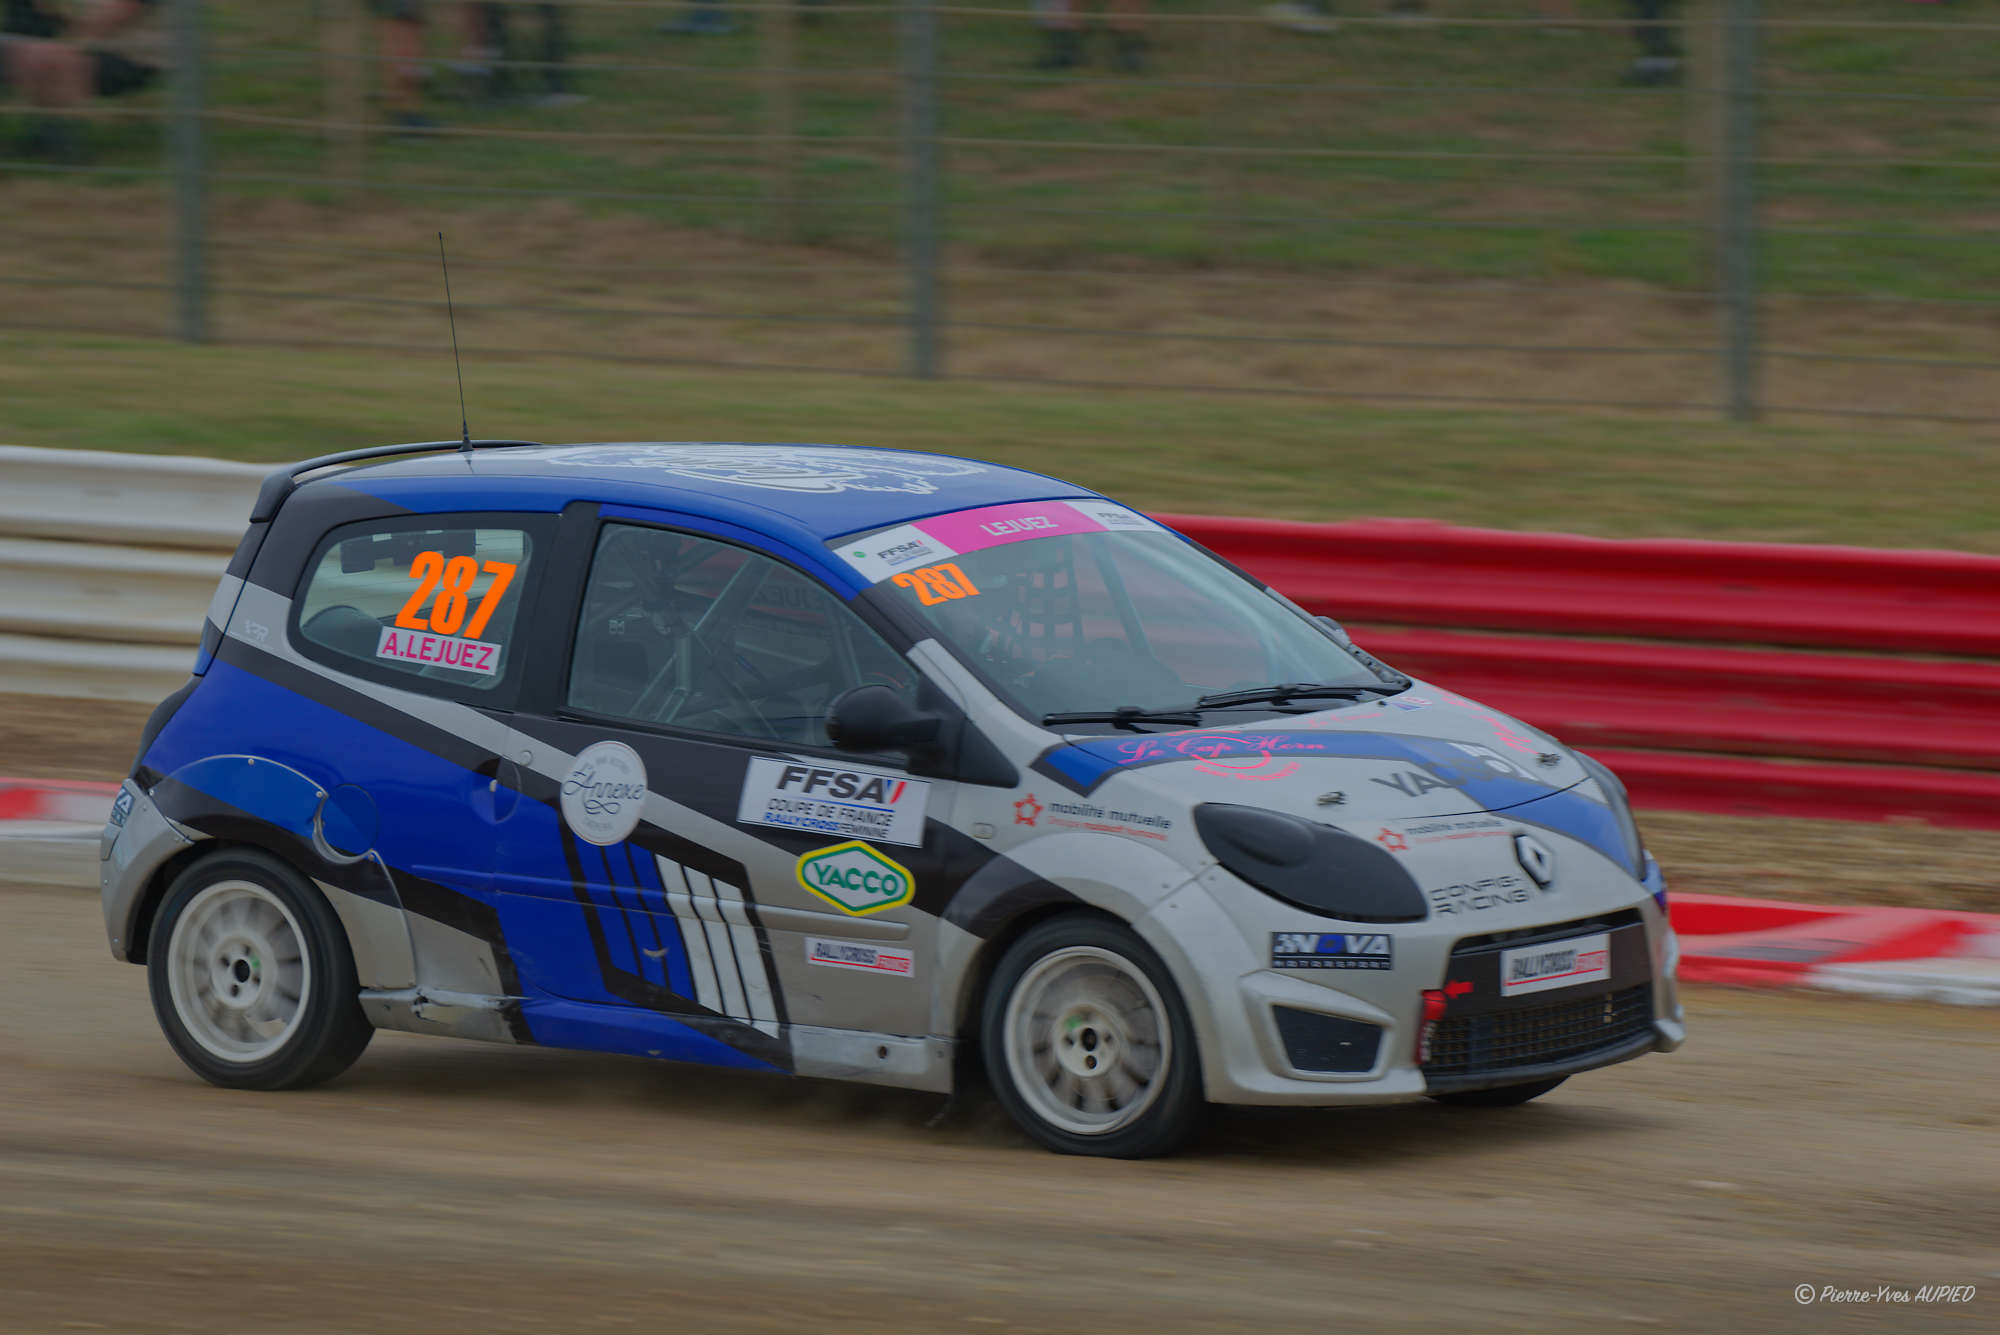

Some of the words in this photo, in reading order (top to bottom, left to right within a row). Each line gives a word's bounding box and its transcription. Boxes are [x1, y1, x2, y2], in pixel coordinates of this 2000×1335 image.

[980, 515, 1058, 536] LEJUEZ
[877, 541, 920, 559] FFSA
[394, 551, 517, 640] 287
[891, 562, 981, 606] 287
[382, 632, 494, 671] A.LEJUEZ
[776, 765, 886, 804] FFSA
[763, 812, 840, 831] RALLYCROSS
[767, 798, 813, 815] COUPE
[815, 804, 835, 818] DE
[838, 807, 894, 826] FRANCE
[1110, 808, 1173, 829] mutuelle
[812, 862, 899, 896] YACCO
[1434, 889, 1529, 914] RACING
